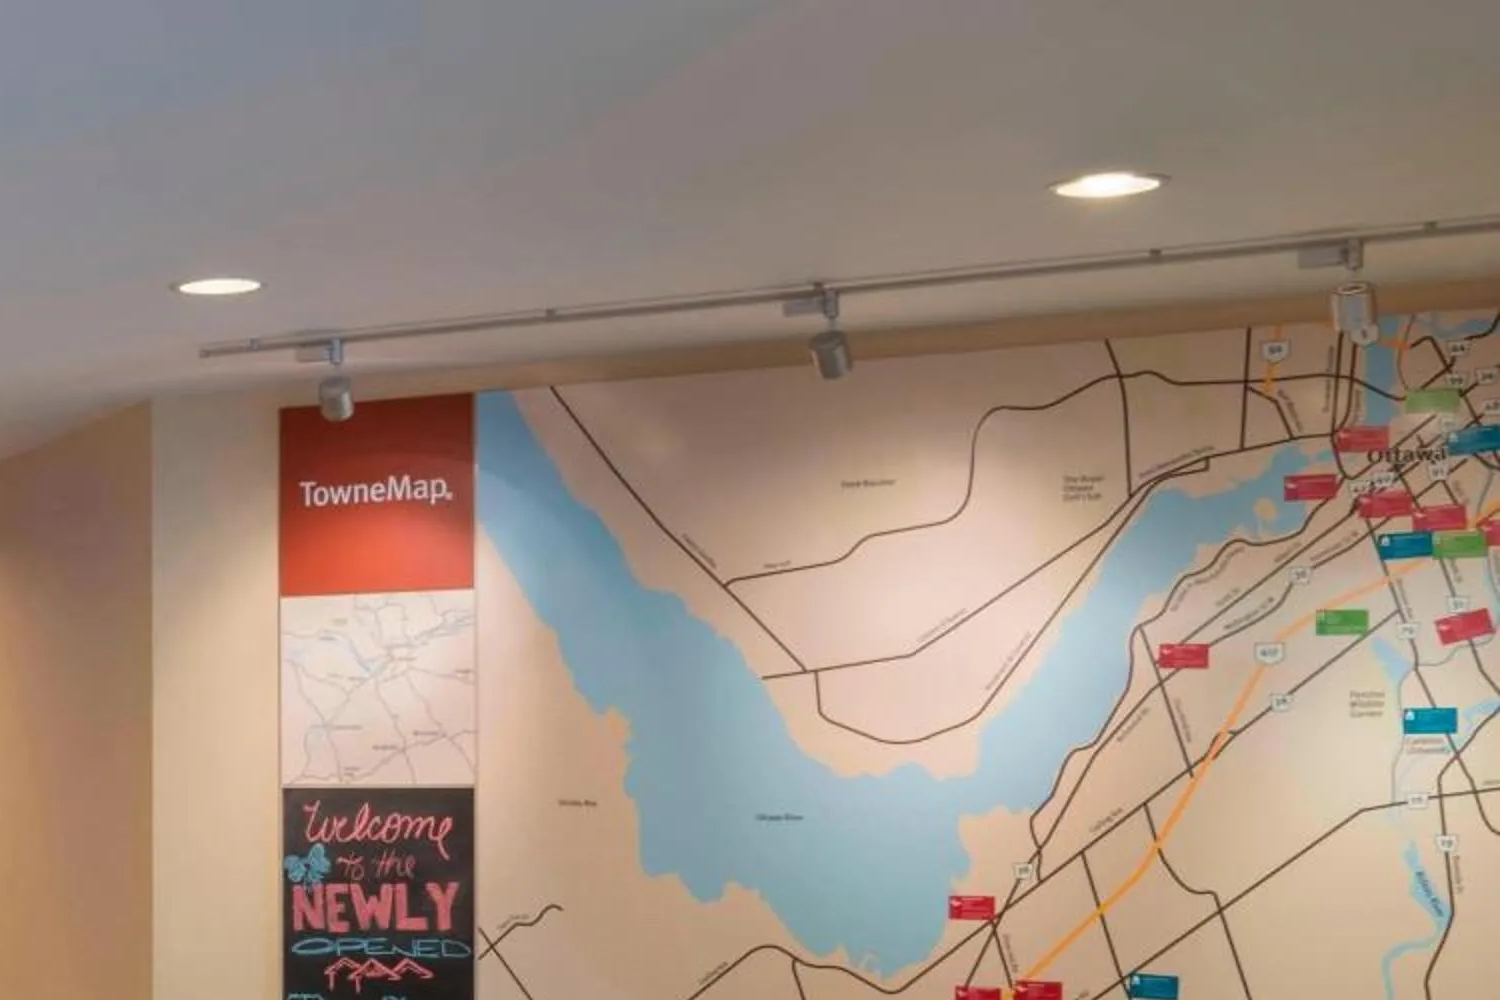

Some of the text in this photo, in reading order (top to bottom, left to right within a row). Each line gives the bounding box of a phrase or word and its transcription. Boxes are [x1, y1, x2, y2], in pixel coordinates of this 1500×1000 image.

[303, 799, 454, 861] Welcome
[335, 848, 417, 881] to the
[291, 881, 461, 933] NEWLY
[290, 936, 473, 959] OPENED
